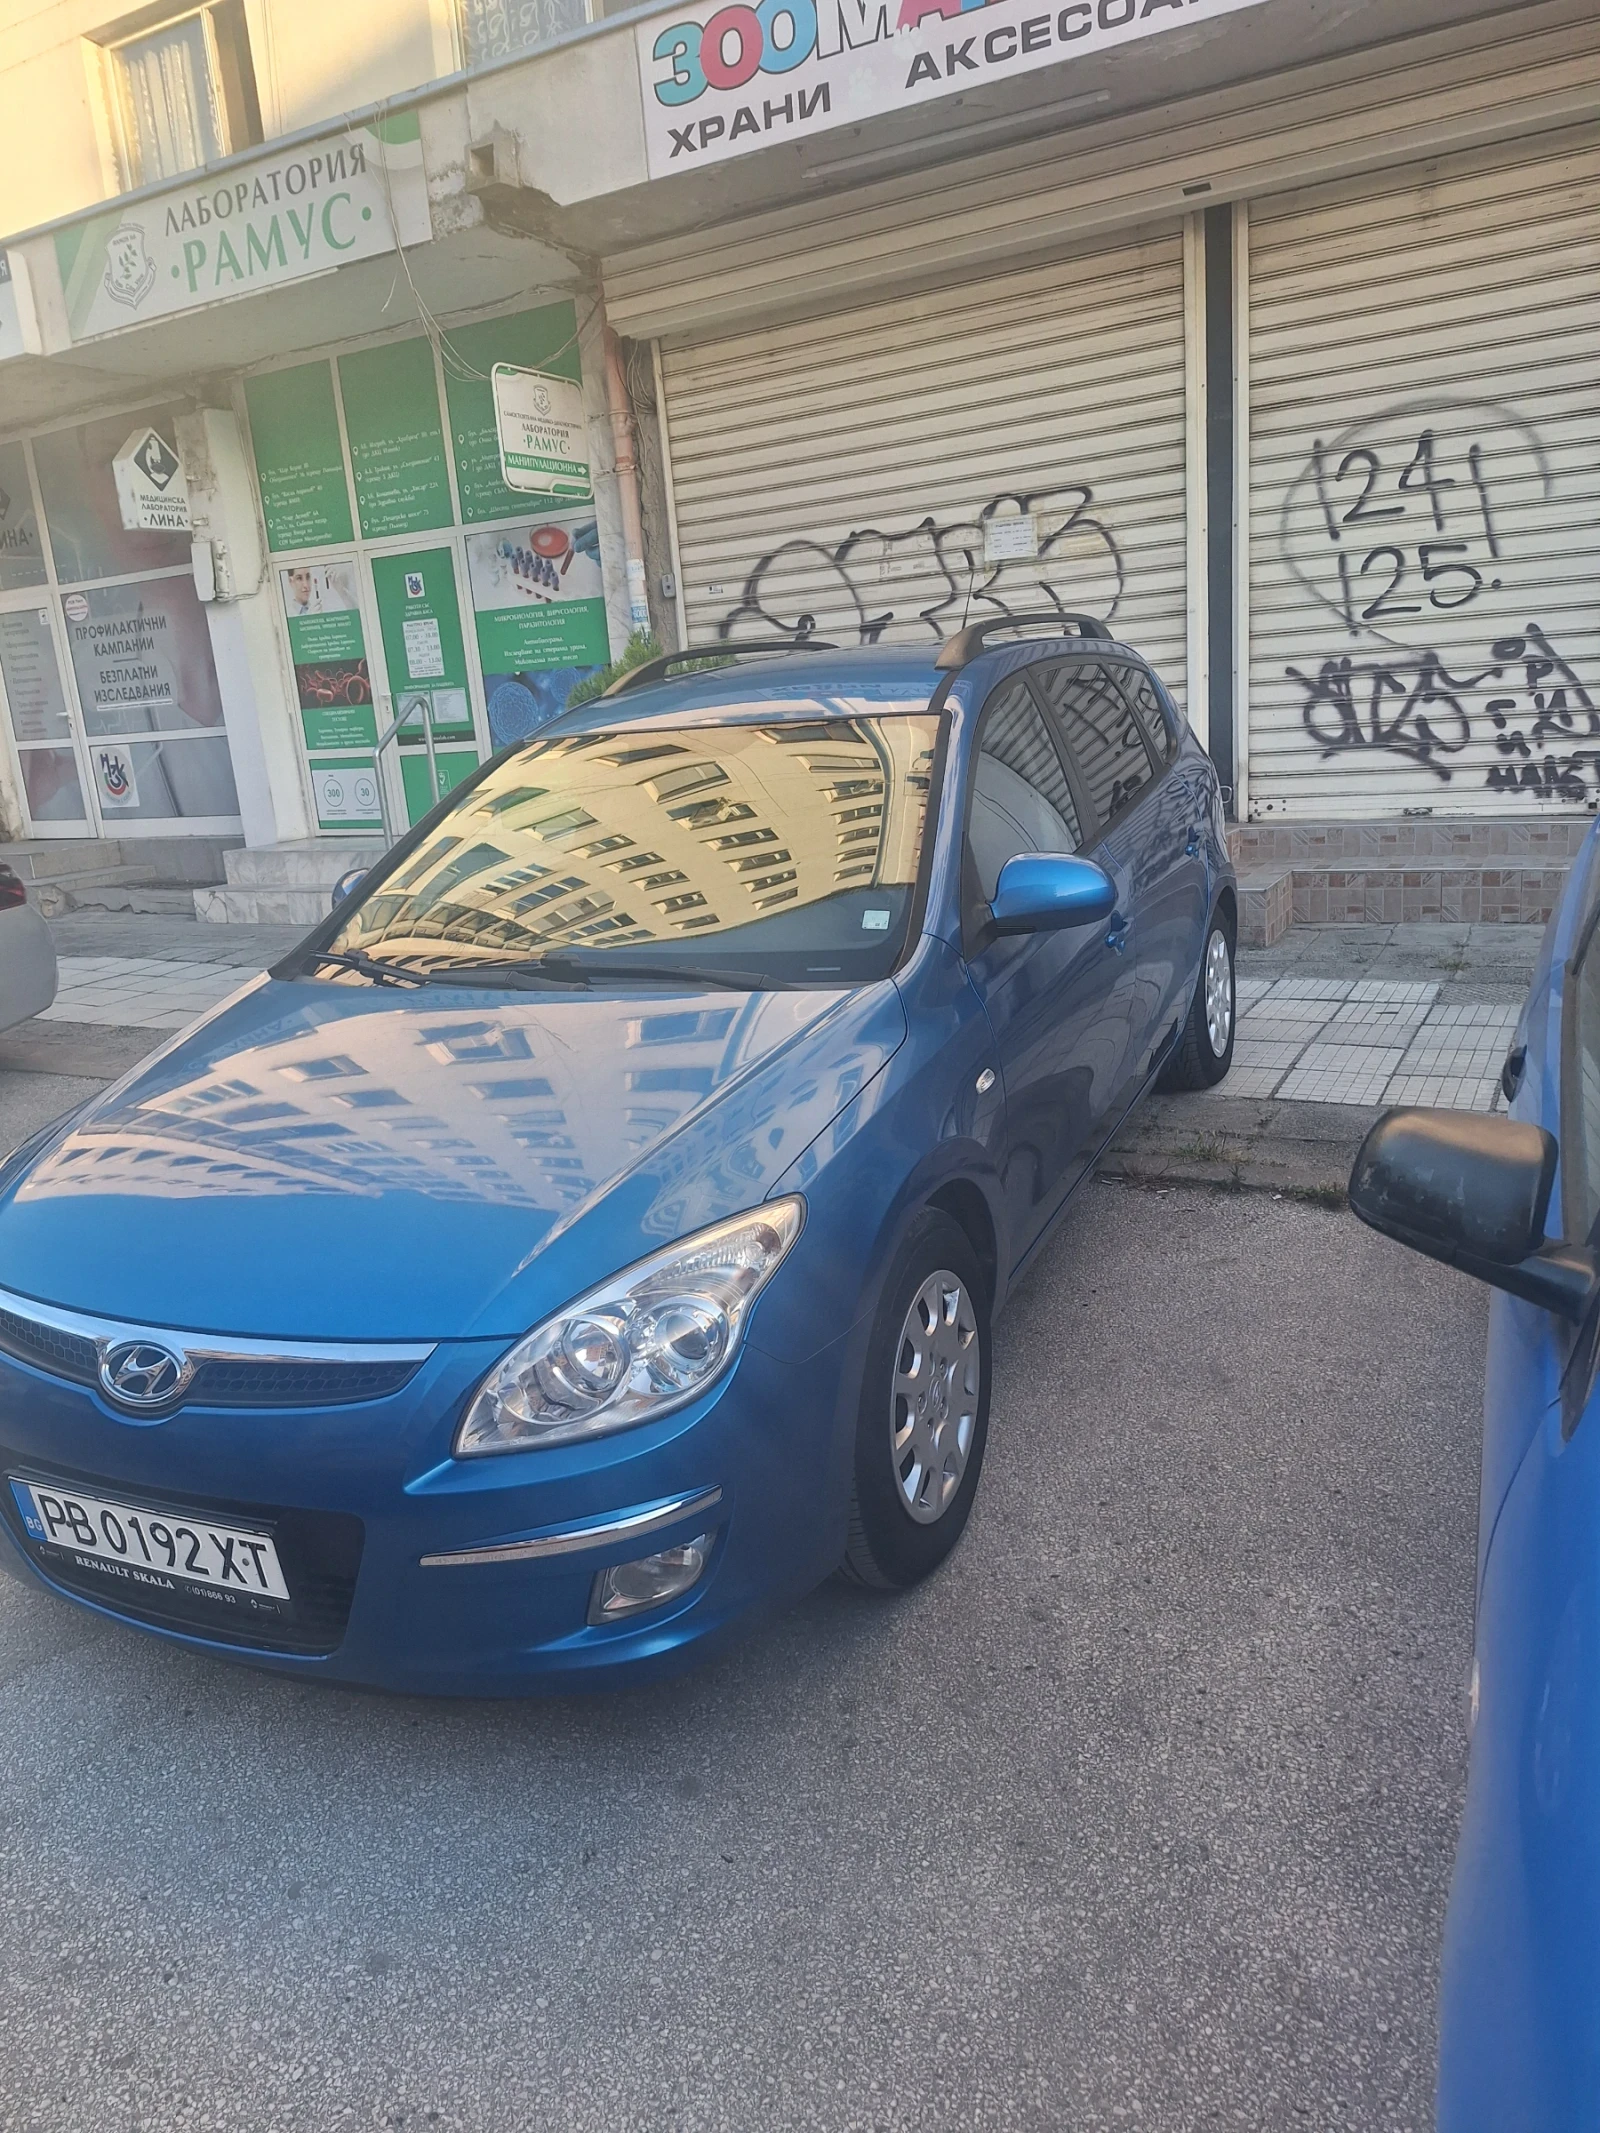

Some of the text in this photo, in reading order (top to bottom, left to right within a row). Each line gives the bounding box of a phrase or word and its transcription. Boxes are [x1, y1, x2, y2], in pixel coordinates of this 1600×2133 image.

[667, 82, 831, 158] ХРАНИ
[165, 142, 368, 237] ЛАБОРАТОРИЯ
[522, 423, 570, 438] ЛАБОРАТОРИЯ
[508, 455, 578, 474] МАНИПУЛАЦИОННА
[140, 494, 186, 504] МЕДИЦИНСКА
[141, 503, 187, 513] ЛАБОРАТОРИЯ
[75, 616, 167, 640] ПРОФИЛАКТИЧНИ
[93, 637, 154, 657] КАМПАНИИ
[100, 665, 158, 684] БЕЗПЛАТНИ
[94, 682, 171, 702] ИЗСЛЕДВАНИЯ
[327, 789, 340, 797] 300
[361, 788, 369, 796] 30
[25, 1516, 42, 1531] BG
[75, 1556, 130, 1579] RENAULT
[133, 1571, 175, 1590] SKALA
